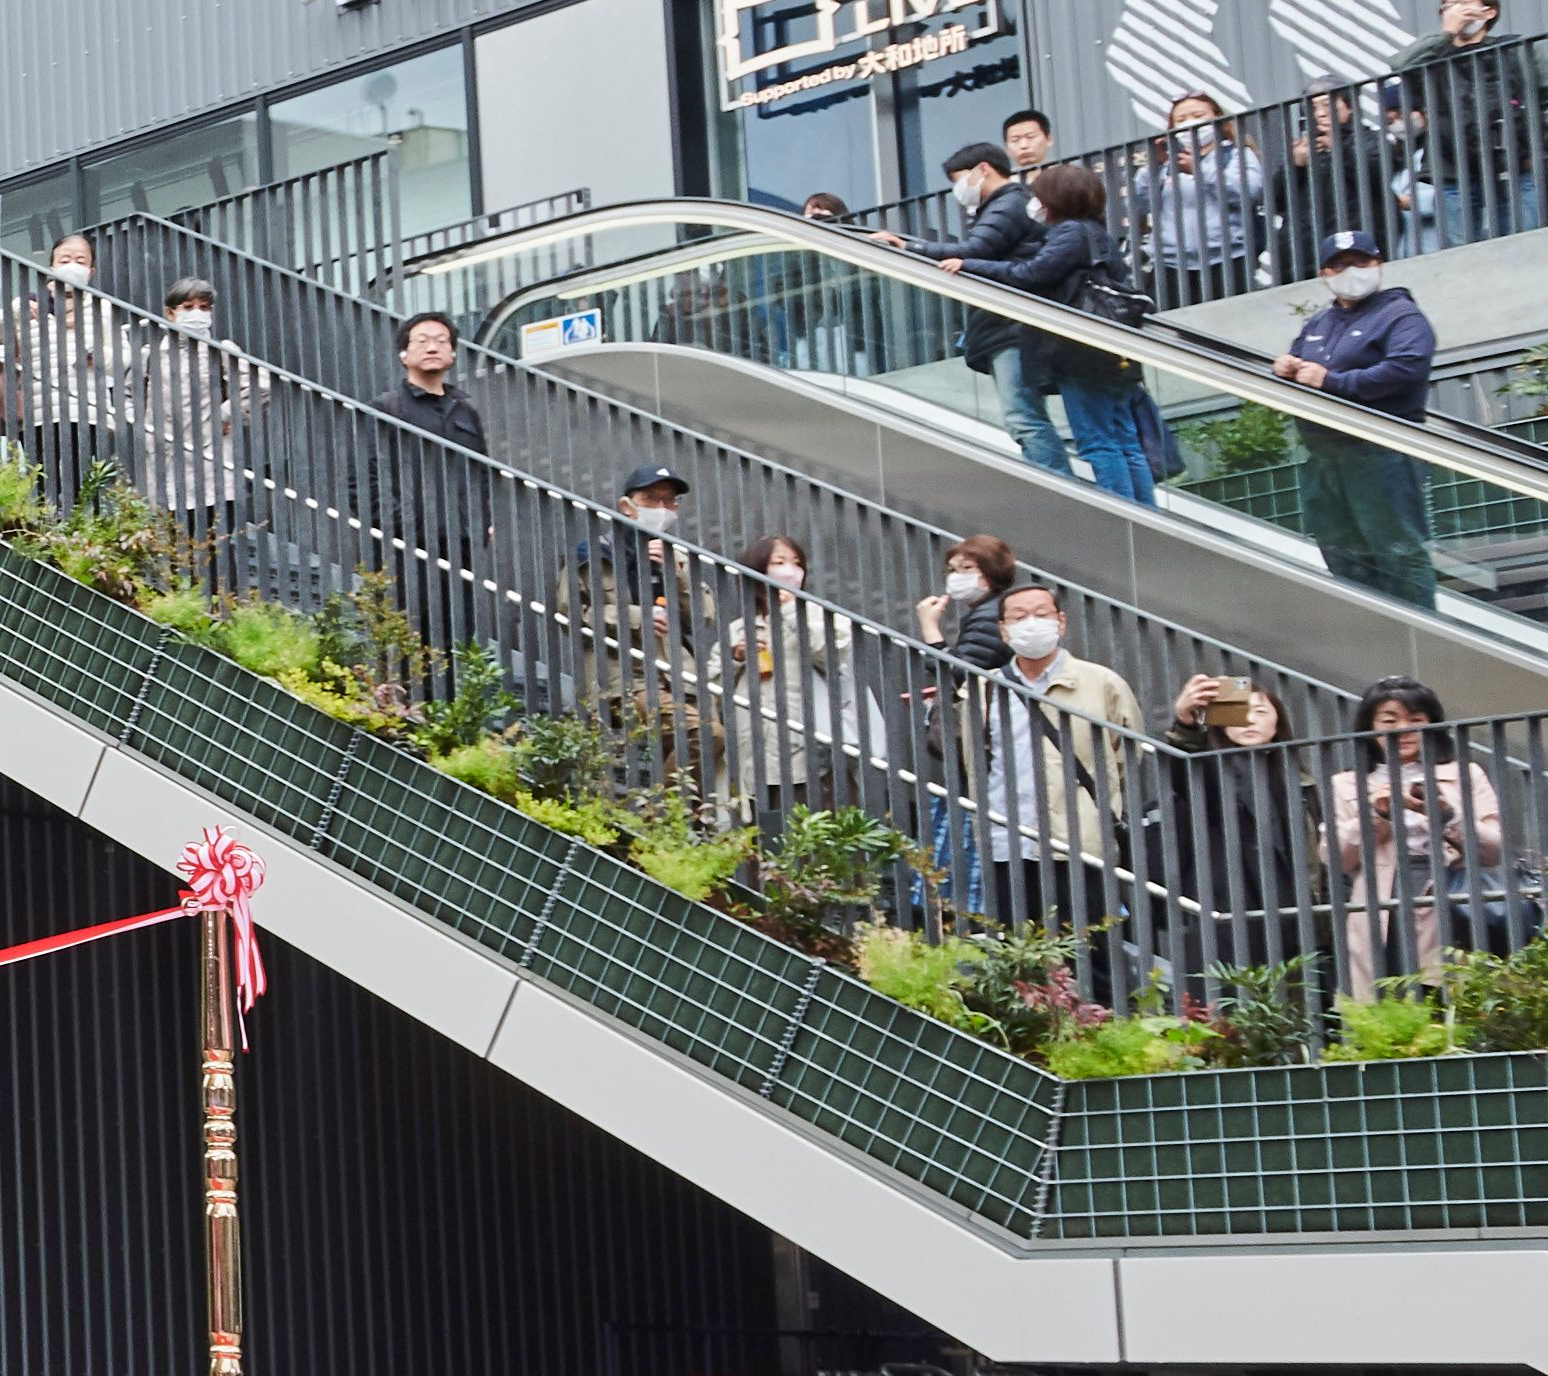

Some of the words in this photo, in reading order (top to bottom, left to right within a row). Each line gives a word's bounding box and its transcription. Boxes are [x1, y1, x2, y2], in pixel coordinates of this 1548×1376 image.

[740, 68, 831, 106] Supported
[833, 63, 856, 82] by
[858, 25, 967, 79] 大和地所
